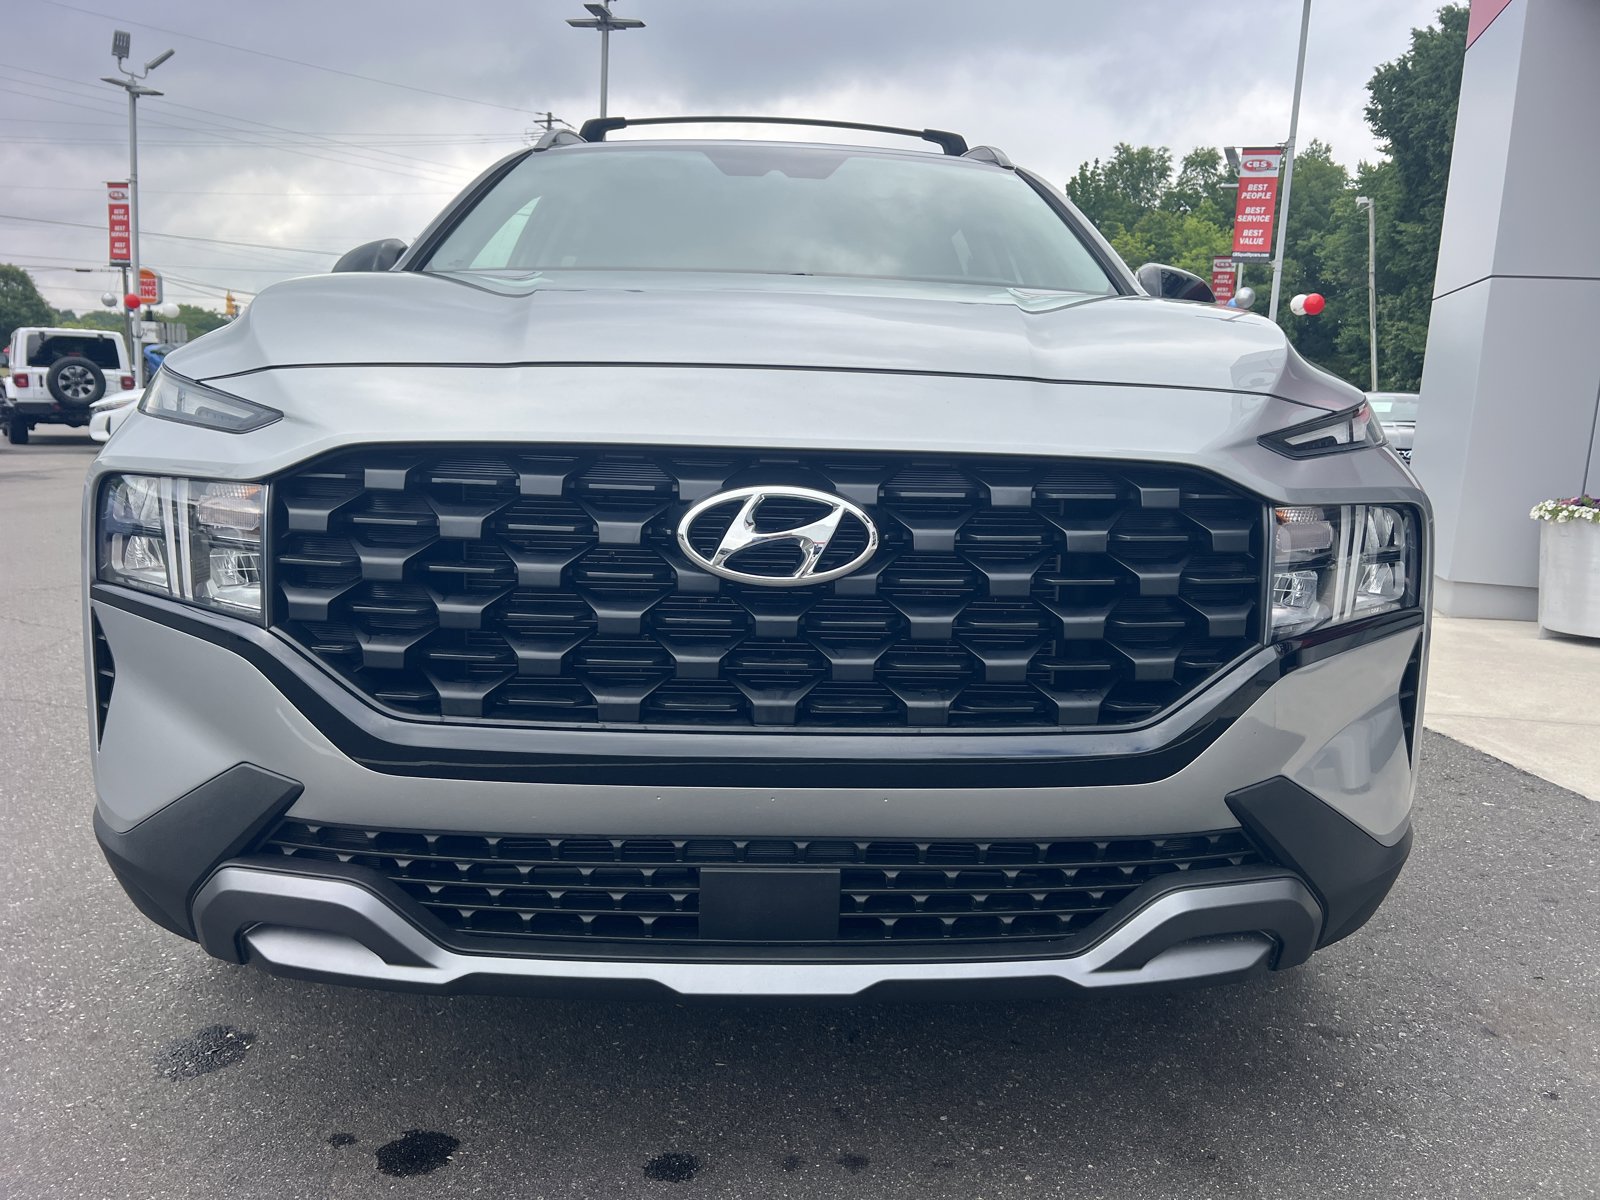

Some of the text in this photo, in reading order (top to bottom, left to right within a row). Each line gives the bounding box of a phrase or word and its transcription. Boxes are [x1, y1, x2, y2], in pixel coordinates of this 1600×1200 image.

[1247, 183, 1269, 191] BEST
[1241, 191, 1272, 200] PEOPLE
[1244, 206, 1266, 214] BEST
[1237, 214, 1271, 222] SERVICE
[1242, 229, 1264, 237] BEST
[1239, 237, 1265, 245] VALUE
[140, 288, 156, 296] ING
